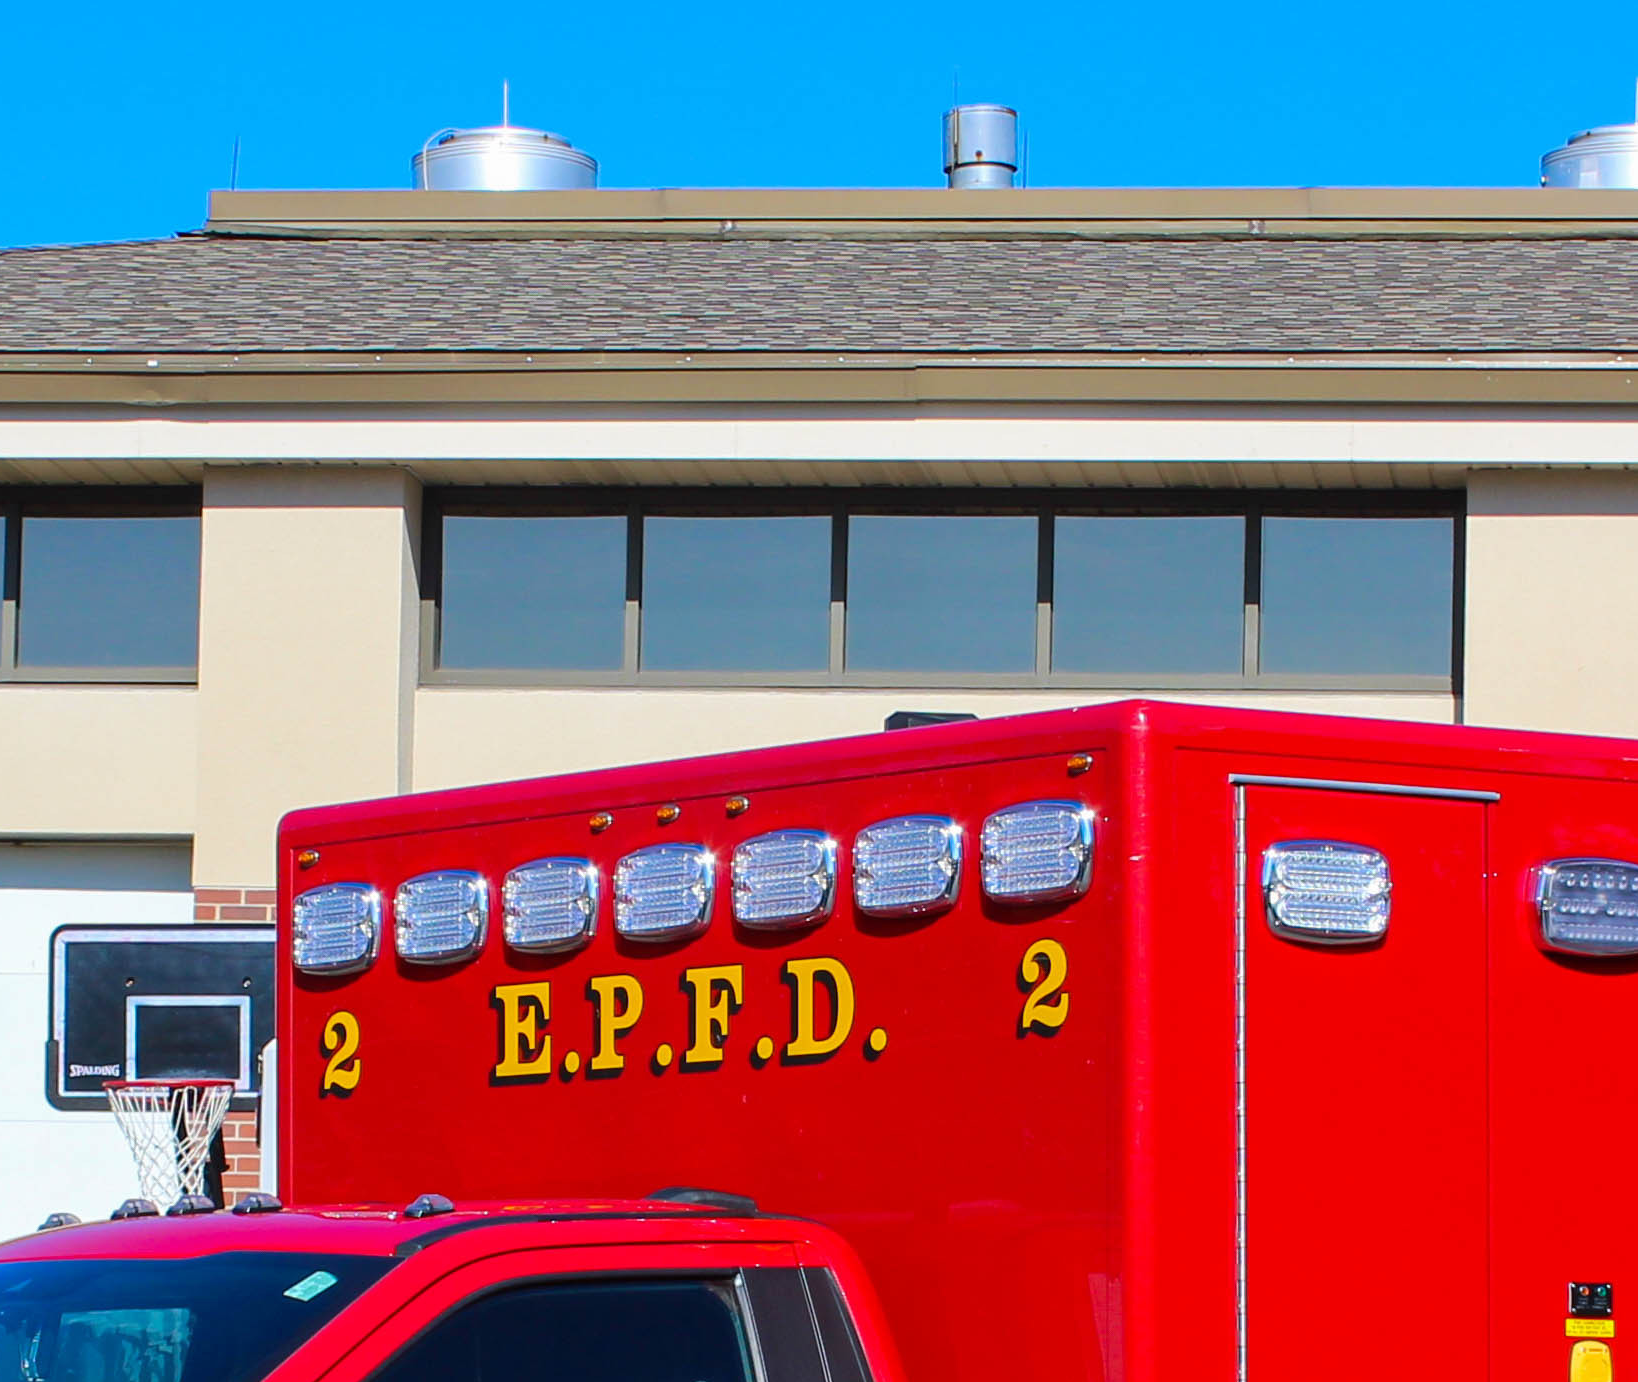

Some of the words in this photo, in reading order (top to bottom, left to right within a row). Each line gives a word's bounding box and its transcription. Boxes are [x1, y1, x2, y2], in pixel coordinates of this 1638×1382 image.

[494, 957, 887, 1078] E.P.F.D.
[1023, 939, 1069, 1031] 2
[69, 1064, 120, 1078] SPALDING
[323, 1011, 361, 1091] 2
